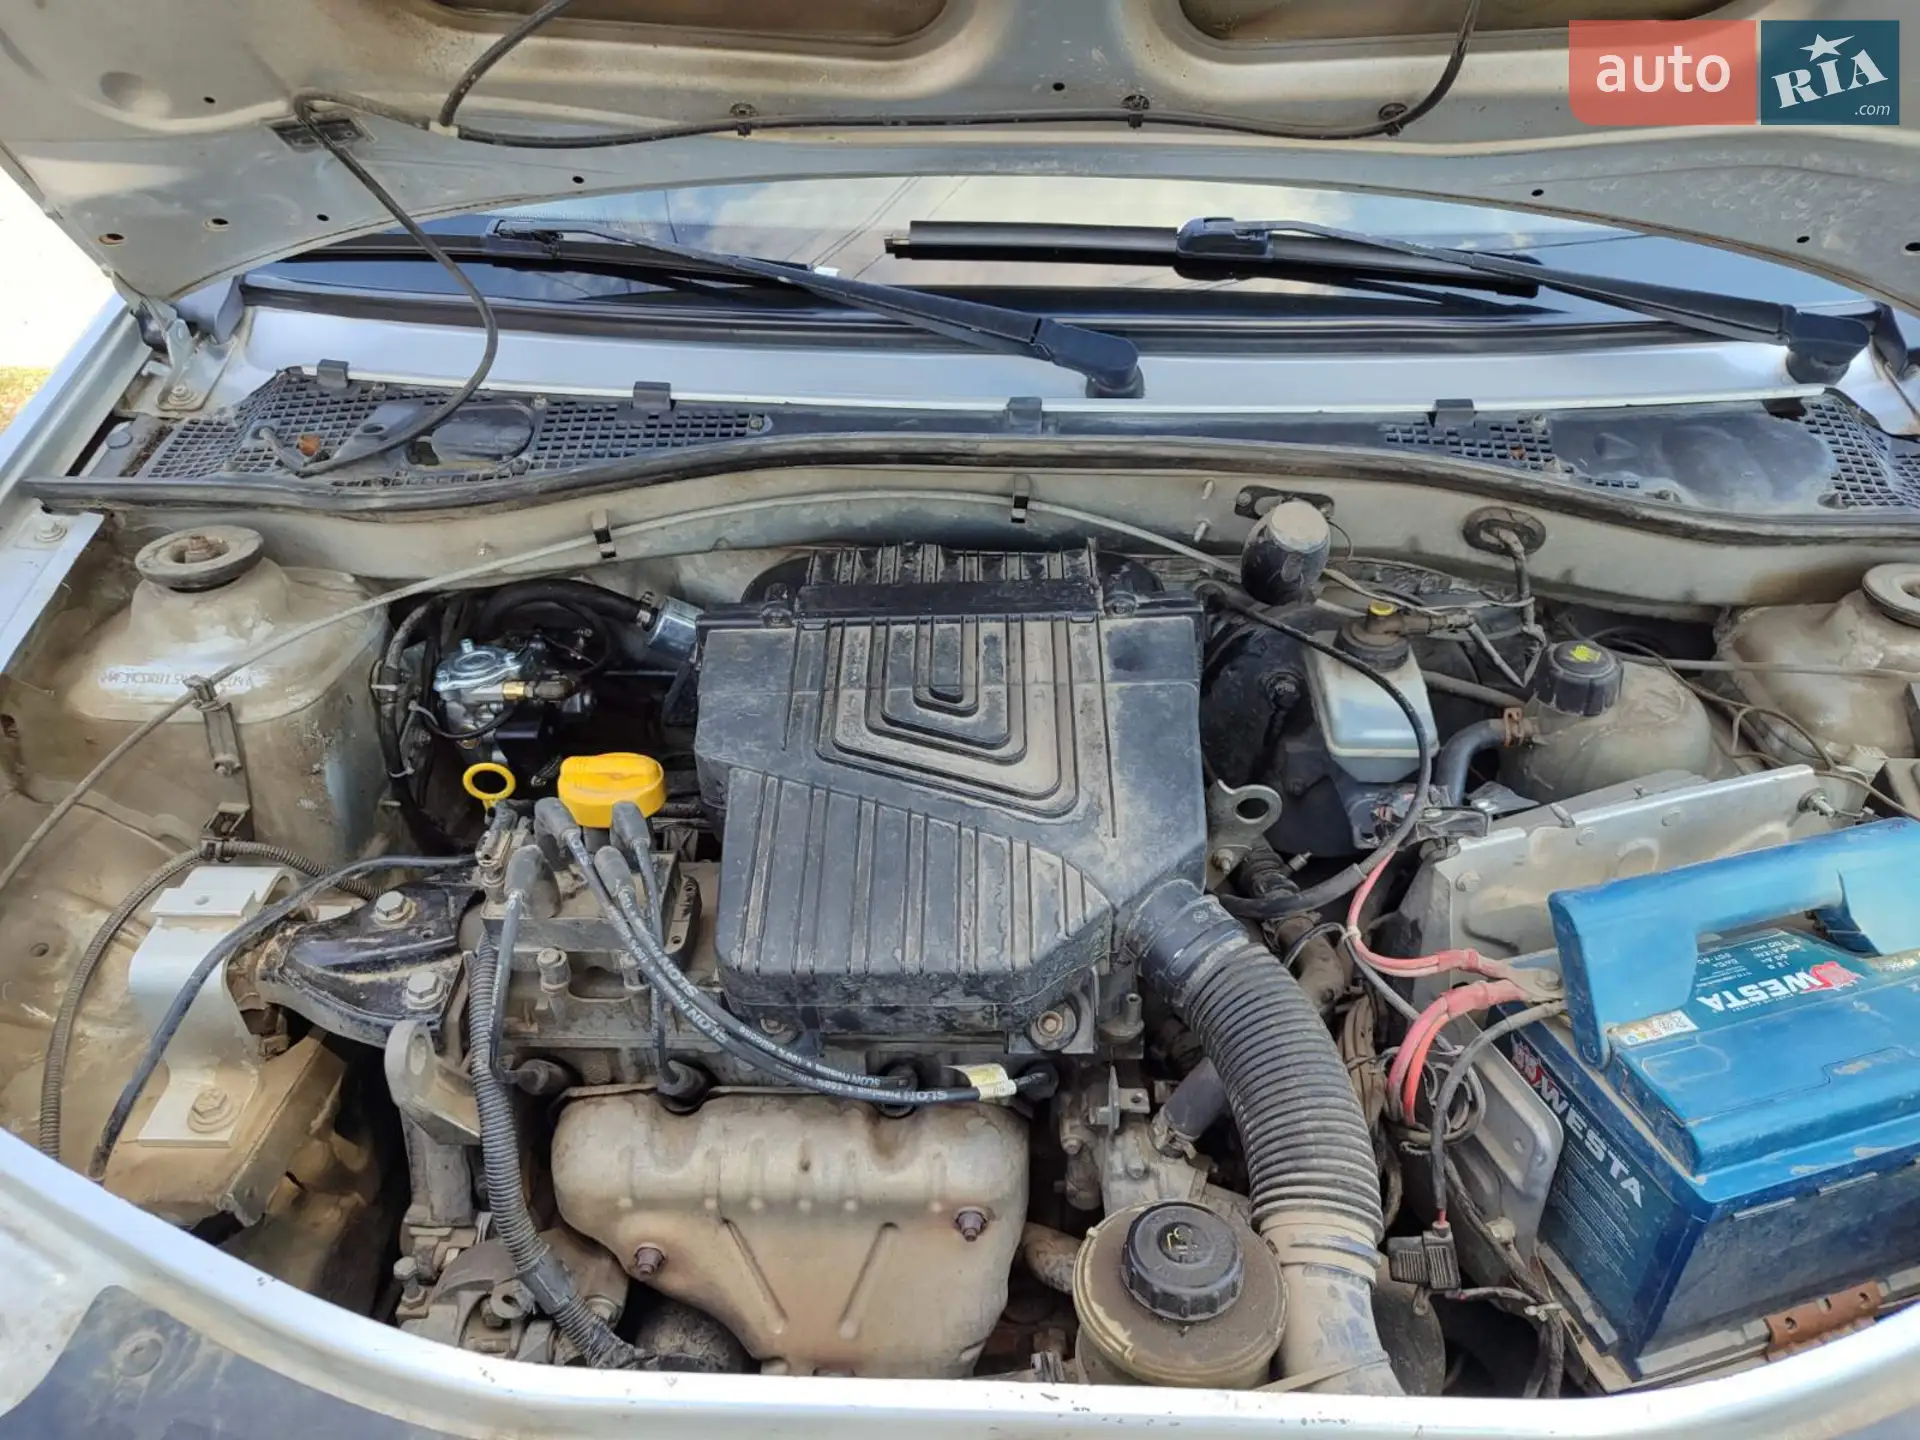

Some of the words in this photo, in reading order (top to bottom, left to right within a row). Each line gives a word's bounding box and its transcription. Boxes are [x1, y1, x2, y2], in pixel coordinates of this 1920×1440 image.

[1696, 971, 1824, 1012] WESTA
[687, 1008, 728, 1044] SLON
[850, 1073, 881, 1087] SLON
[902, 1090, 949, 1102] SLON
[1540, 1073, 1643, 1209] WESTA
